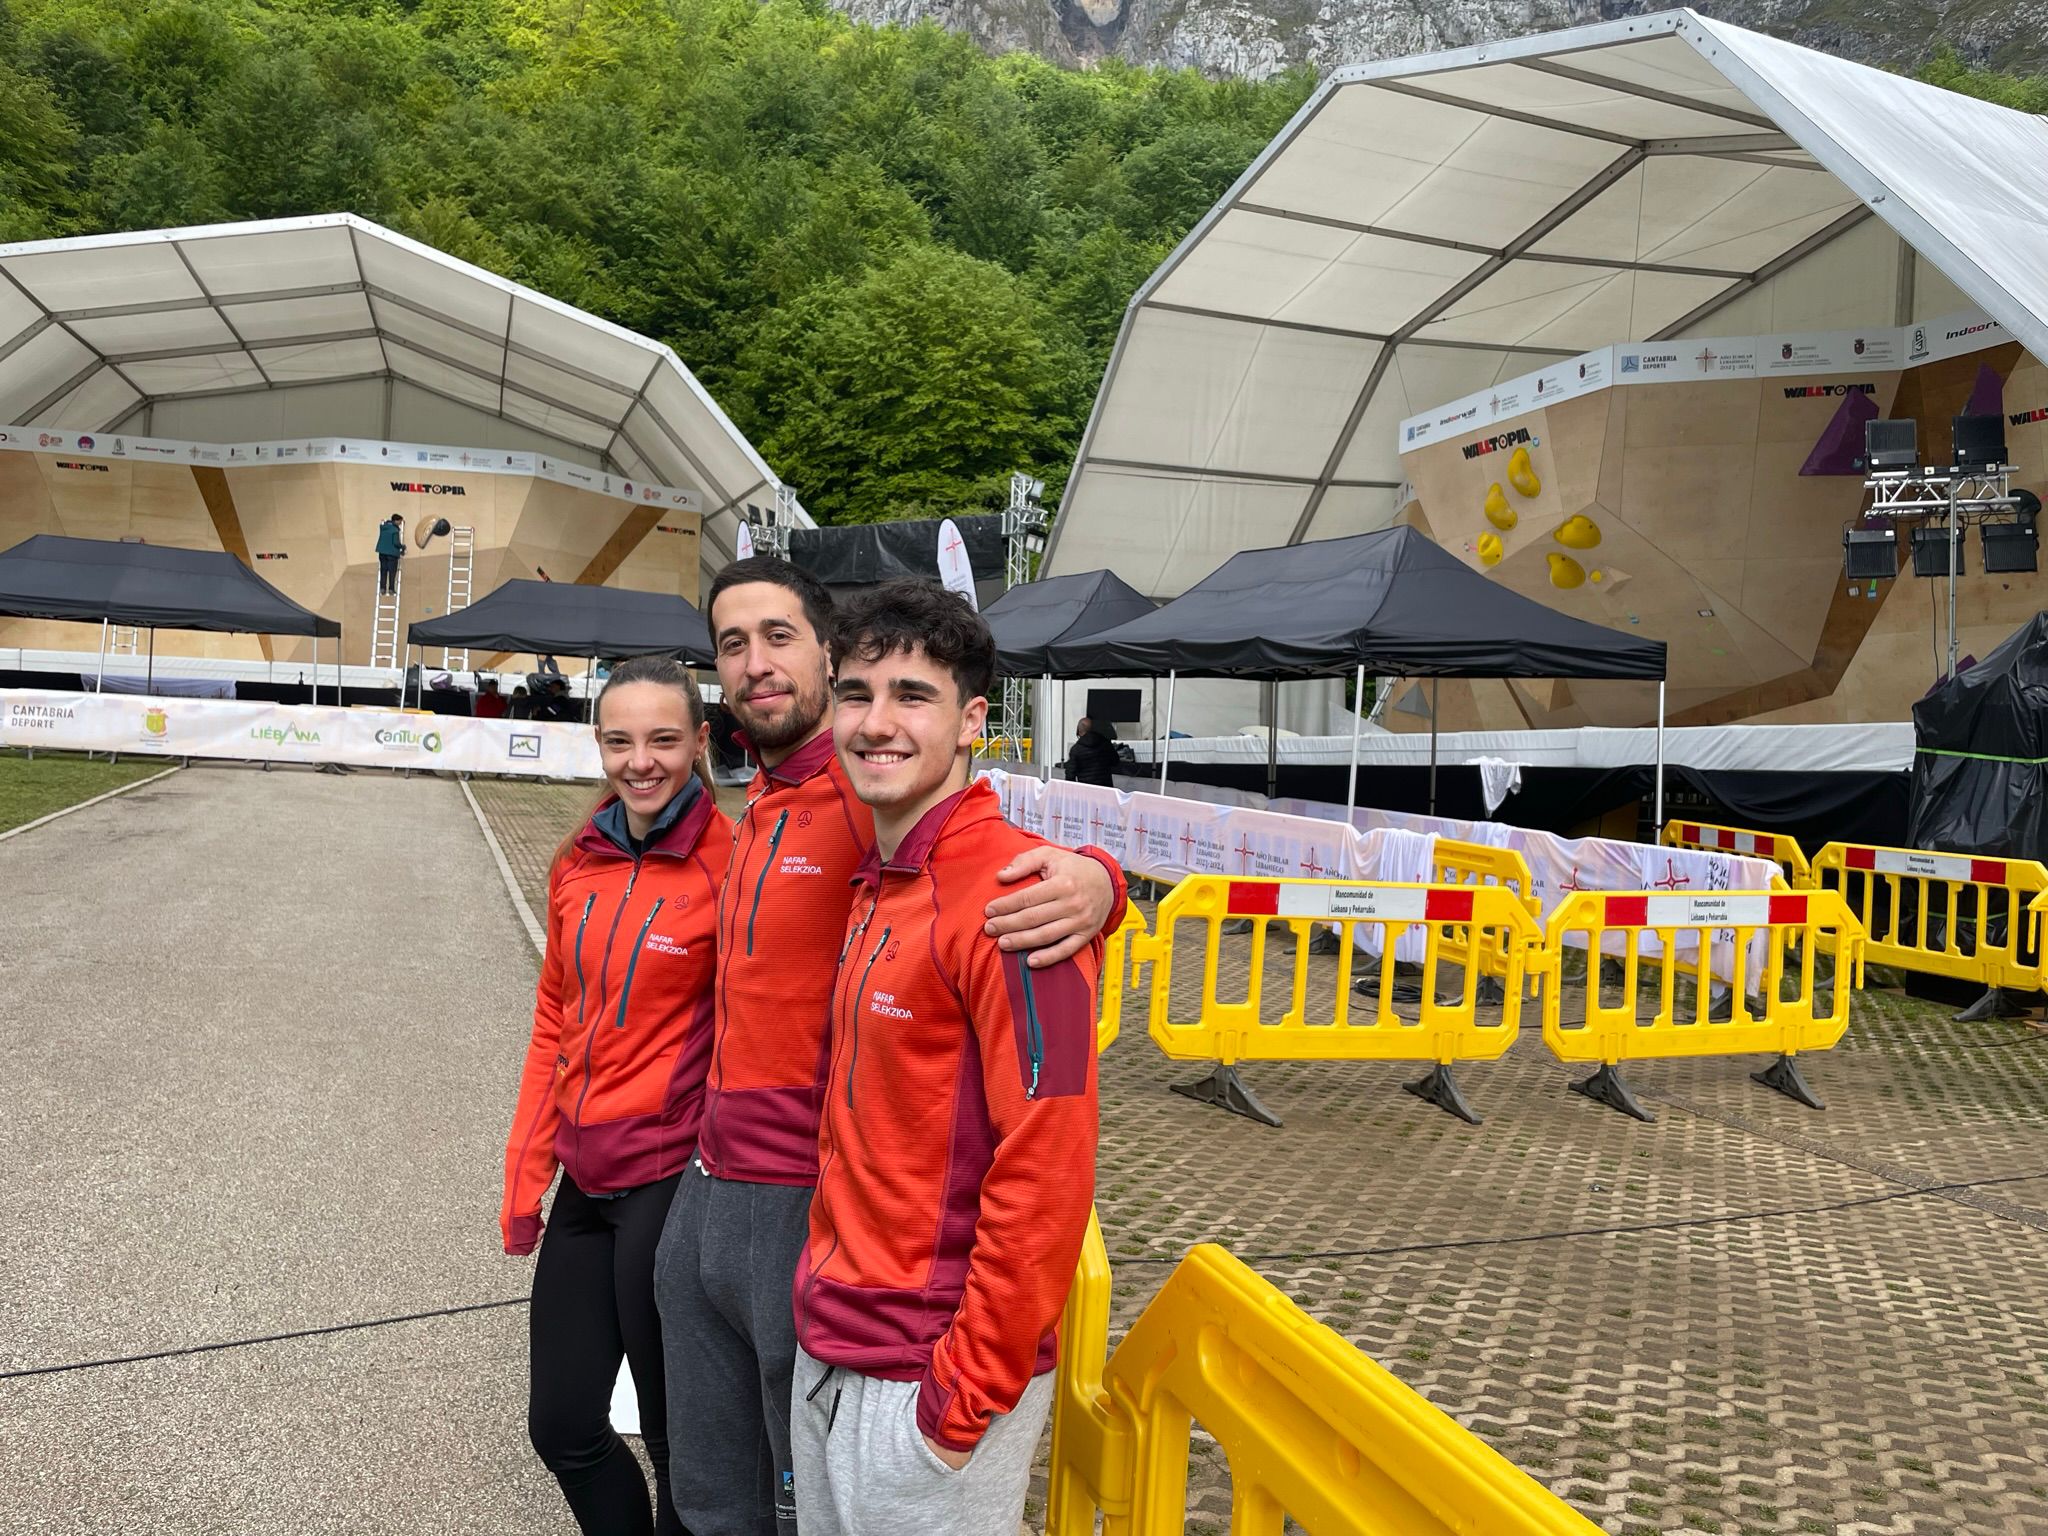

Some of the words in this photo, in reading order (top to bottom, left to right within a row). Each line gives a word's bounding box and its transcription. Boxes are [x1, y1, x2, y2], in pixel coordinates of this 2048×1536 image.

[1643, 355, 1677, 363] CANTABRIA
[1462, 427, 1531, 460] WALLTOPIA
[390, 481, 466, 496] WALLTOPIA
[13, 704, 75, 719] CANTABRIA
[11, 717, 55, 729] DEPORTE
[783, 856, 807, 865] NAFAR
[1256, 851, 1267, 860] AÑO
[1267, 854, 1289, 865] JUBILAR
[780, 865, 822, 874] SELEKZIOA
[1335, 889, 1367, 899] Mancomunidad
[1367, 891, 1374, 899] de
[649, 933, 674, 944] NAFAR
[646, 941, 689, 955] SELEKZIOA
[873, 991, 894, 1004] NAFAR
[870, 1002, 914, 1020] SELEKZIOA
